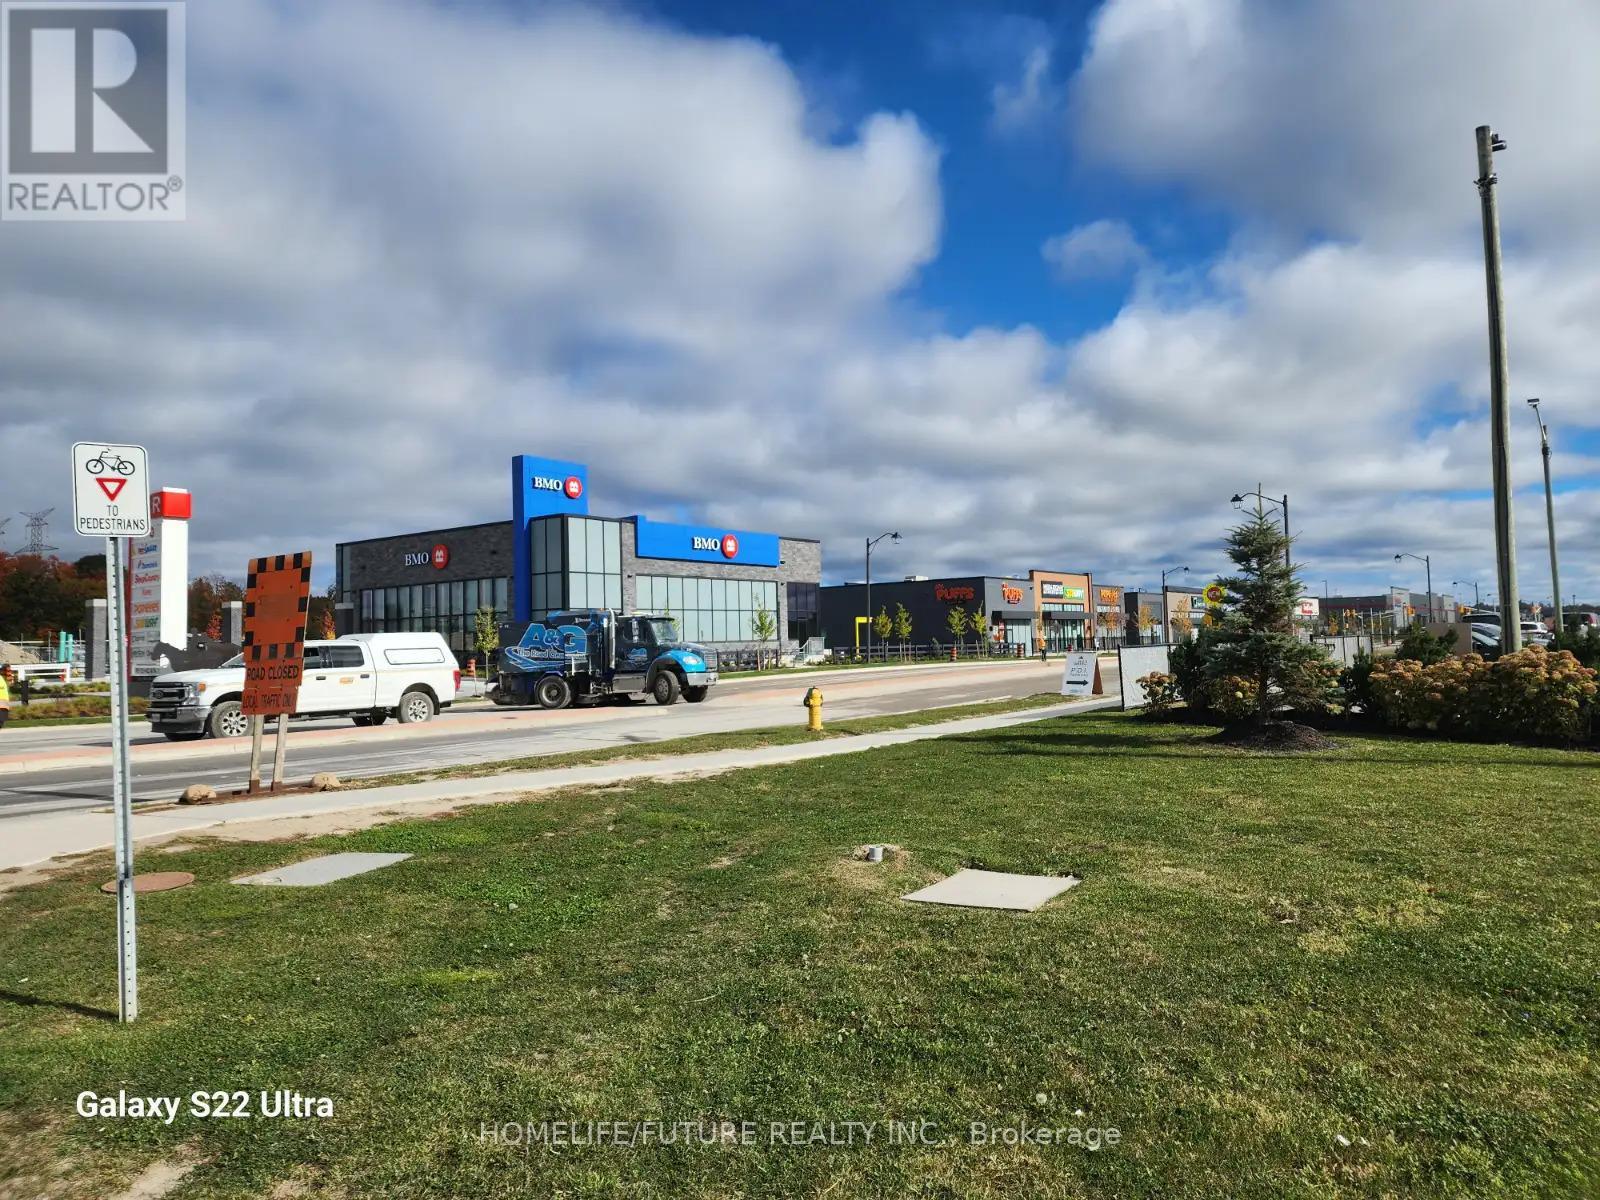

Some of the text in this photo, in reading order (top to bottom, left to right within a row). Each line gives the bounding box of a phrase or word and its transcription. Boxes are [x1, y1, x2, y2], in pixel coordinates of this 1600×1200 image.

[533, 476, 563, 492] BMO
[106, 505, 119, 517] TO
[80, 517, 146, 531] PEDESTRIANS
[692, 536, 721, 551] BMO
[404, 552, 429, 566] BMO
[246, 664, 299, 681] ROAD CLOSED
